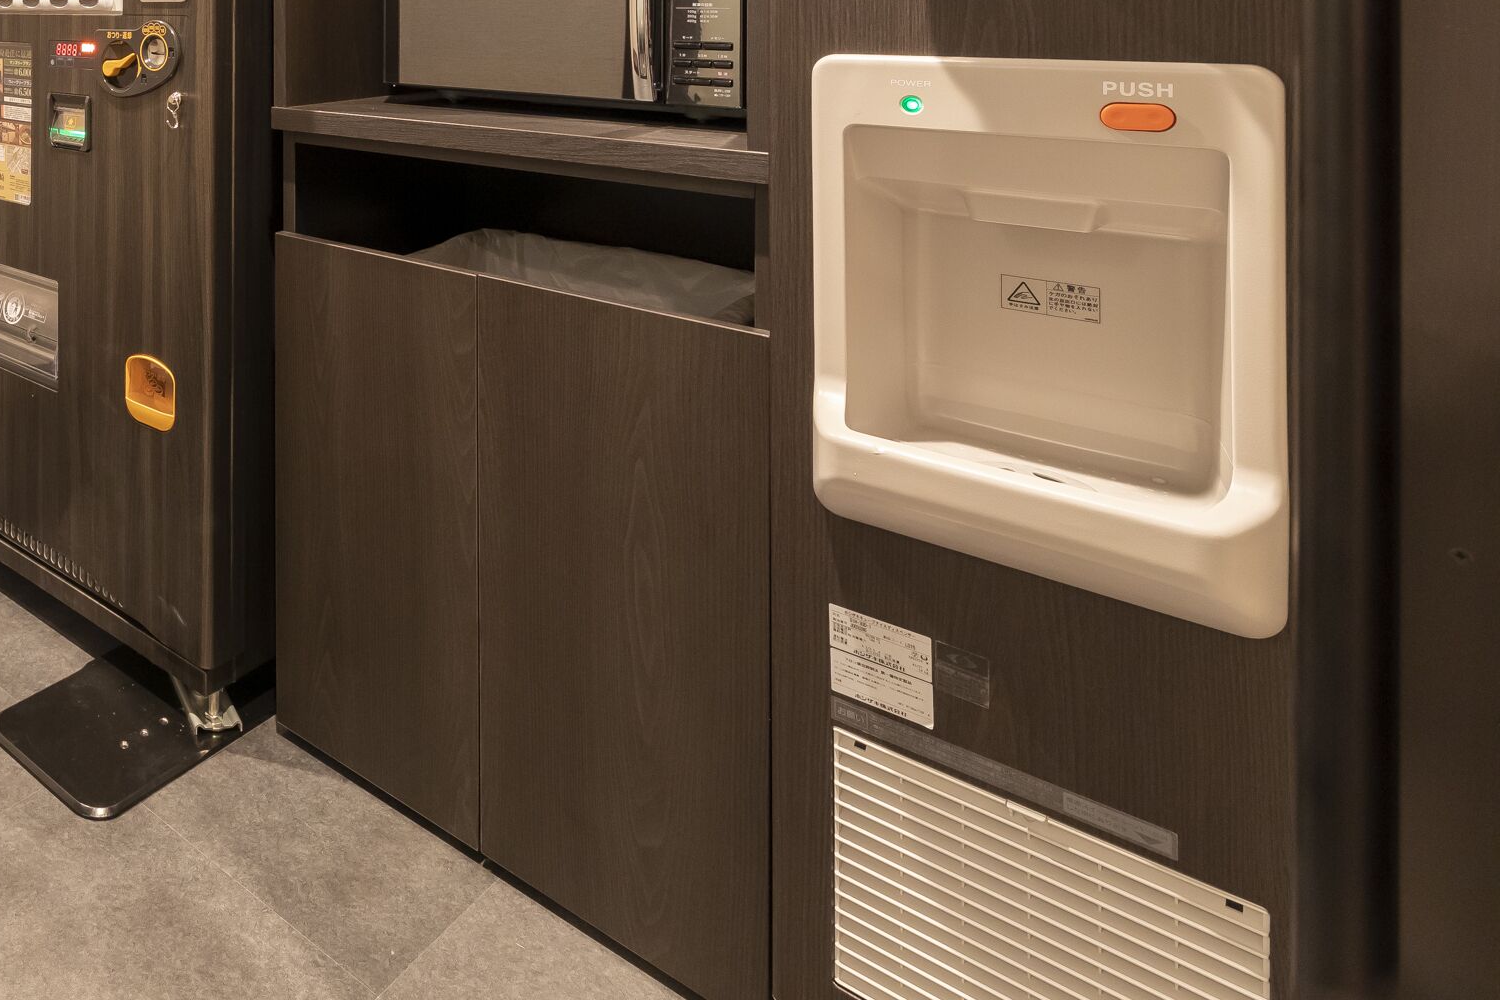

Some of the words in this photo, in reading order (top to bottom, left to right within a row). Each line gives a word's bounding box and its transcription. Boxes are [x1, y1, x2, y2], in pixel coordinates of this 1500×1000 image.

[891, 79, 931, 88] POWER
[1102, 81, 1174, 98] PUSH
[1066, 284, 1087, 294] 警告
[853, 649, 906, 672] ホシザキ株式会社
[854, 693, 907, 717] ホシザキ株式会社
